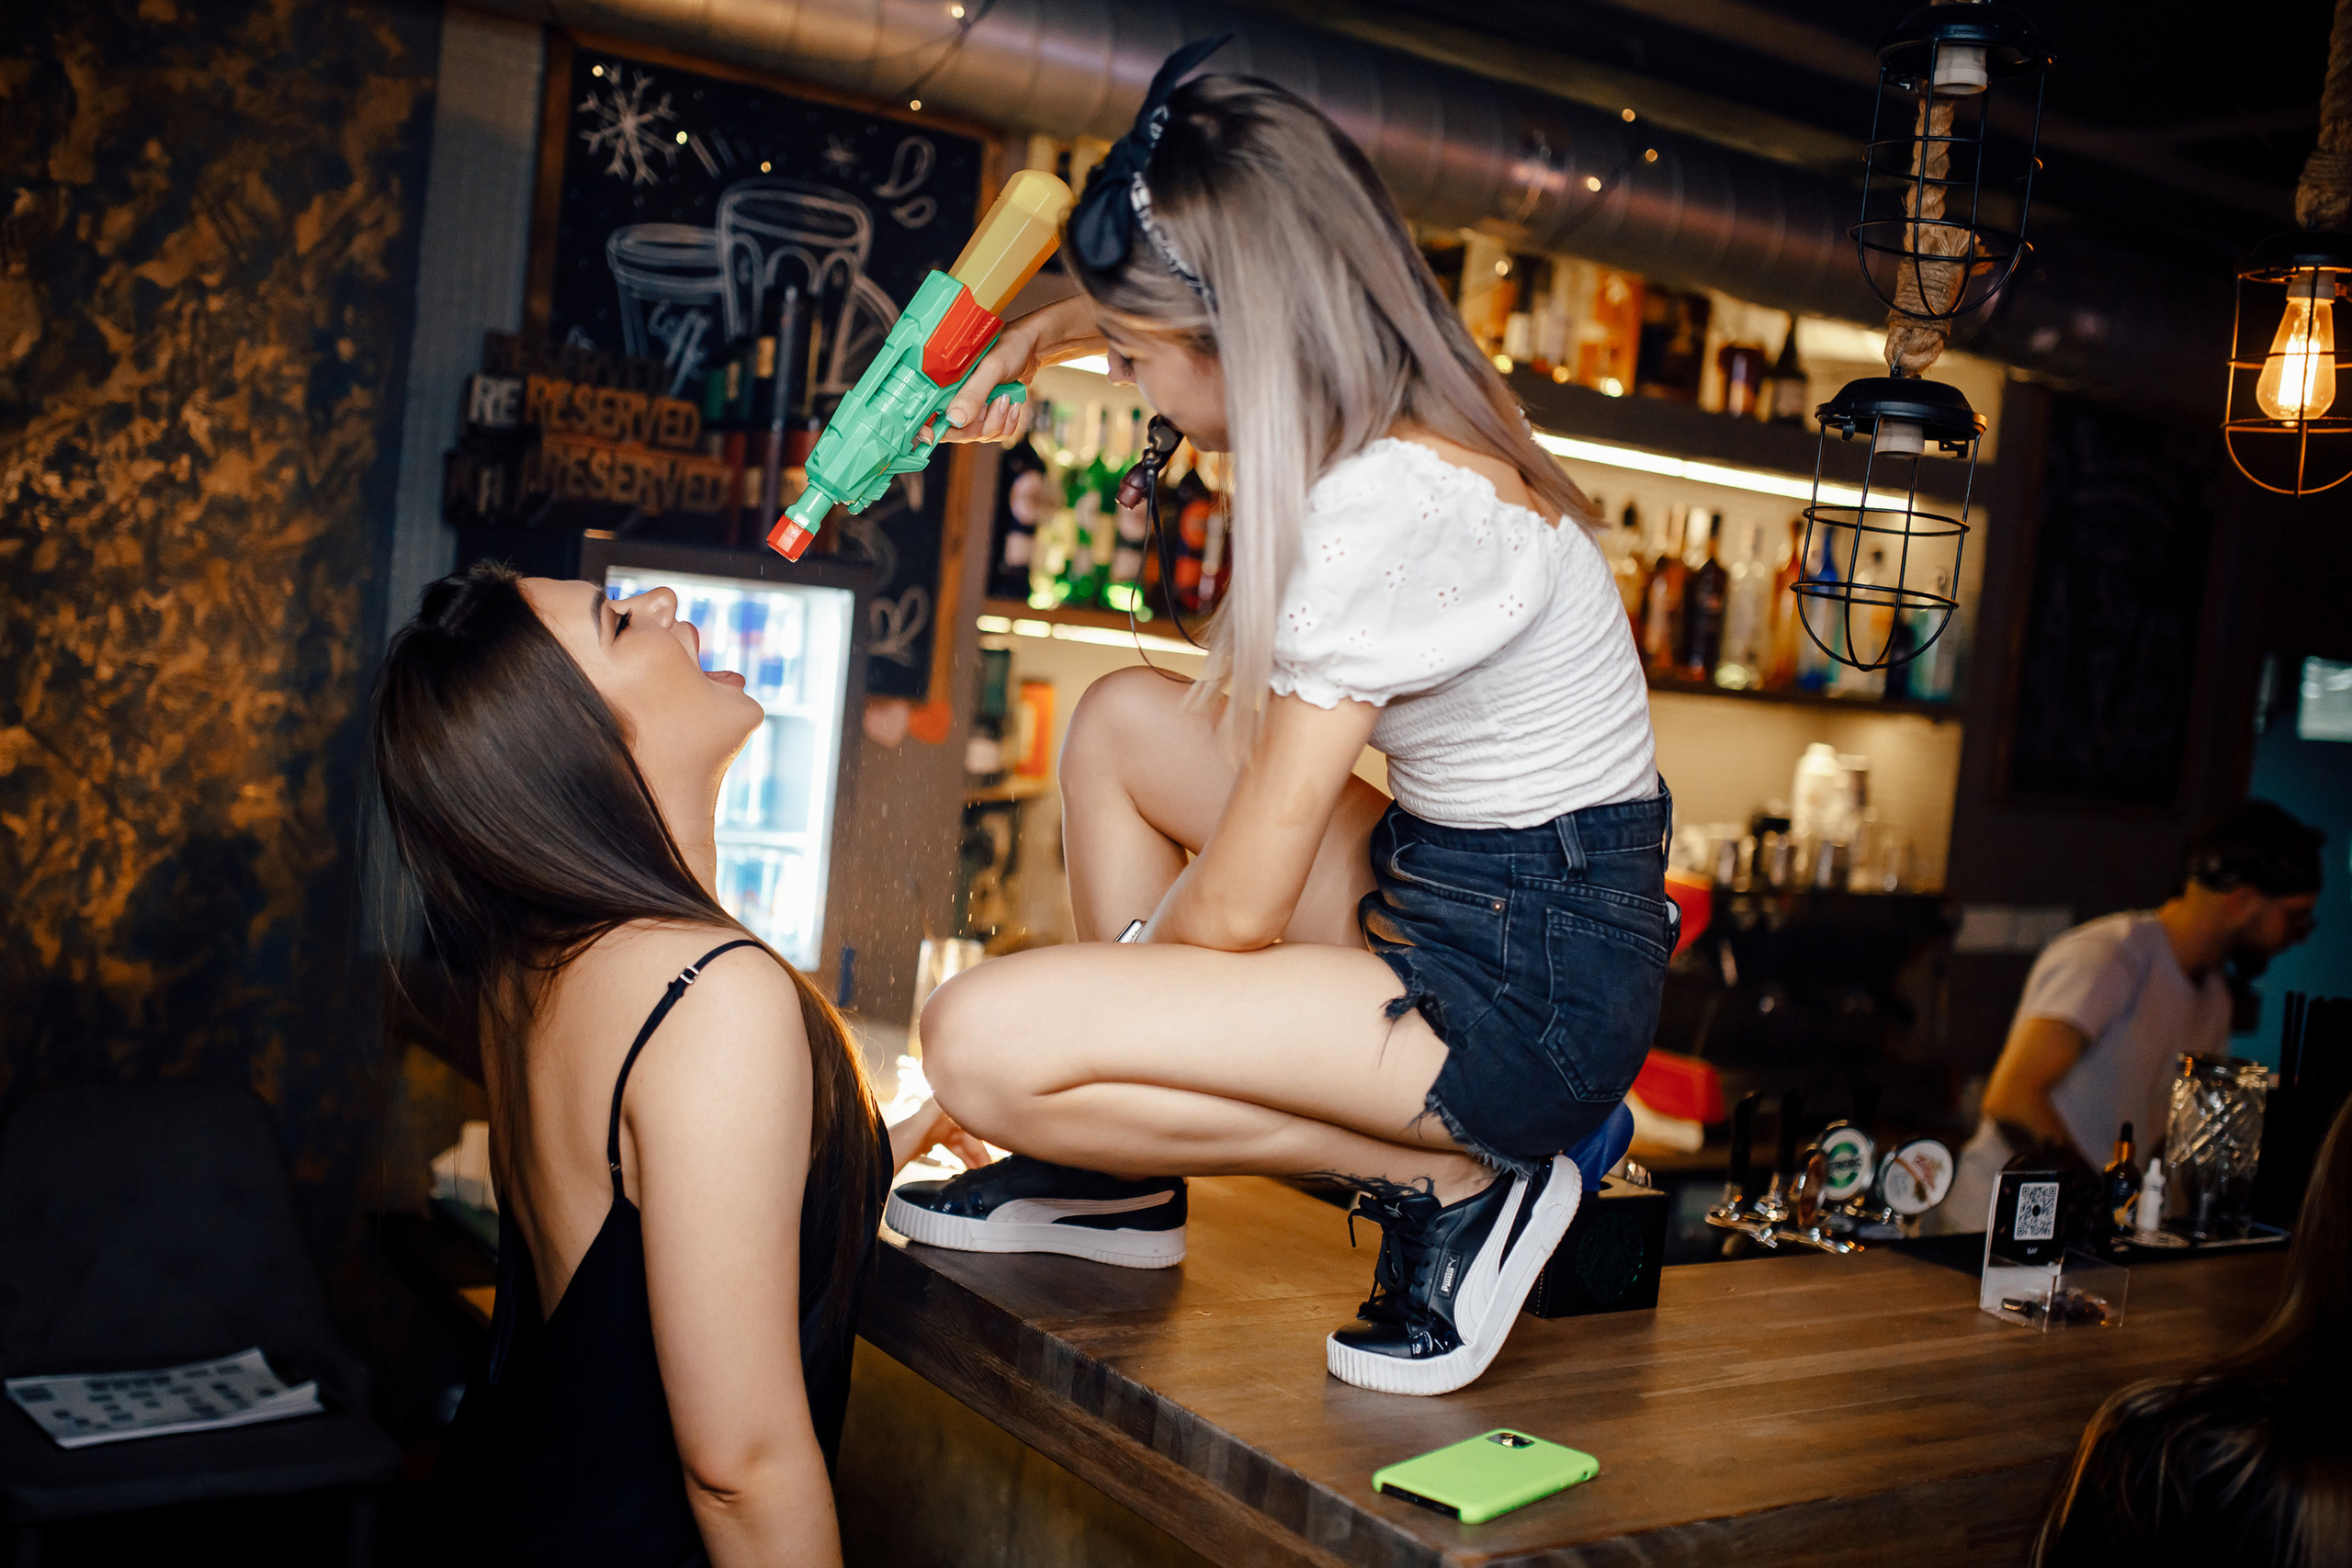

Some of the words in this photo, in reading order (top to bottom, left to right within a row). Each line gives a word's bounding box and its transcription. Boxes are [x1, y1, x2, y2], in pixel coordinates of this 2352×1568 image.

[524, 375, 701, 447] RESERVED
[541, 443, 733, 514] RESERVED
[1441, 1267, 1455, 1292] PUMA
